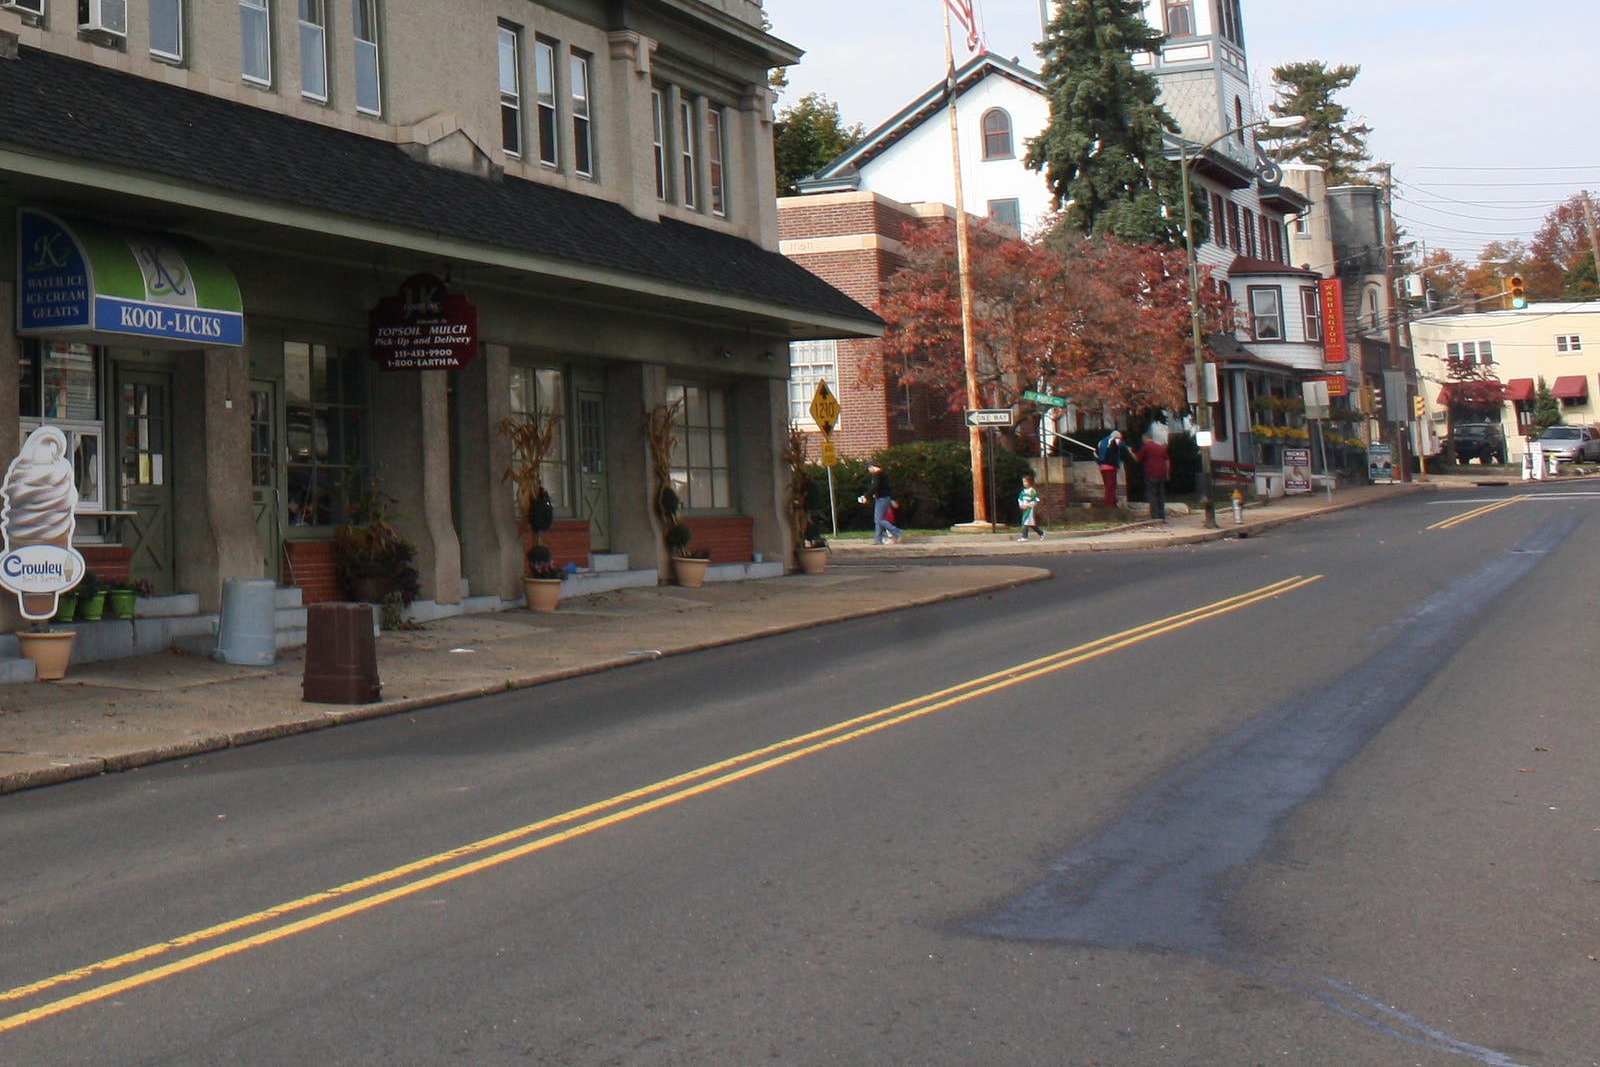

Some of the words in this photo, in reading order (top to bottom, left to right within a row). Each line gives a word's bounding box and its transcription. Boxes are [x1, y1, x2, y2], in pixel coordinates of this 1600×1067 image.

[28, 277, 65, 289] WATER
[67, 275, 84, 285] ICE
[27, 293, 44, 303] ICE
[46, 291, 85, 302] CREAM
[120, 306, 221, 337] KOOL-LICKS
[377, 326, 420, 336] TOPSOIL
[430, 325, 467, 334] MULCH
[434, 336, 471, 344] Delivery
[4, 555, 63, 577] Crowley
